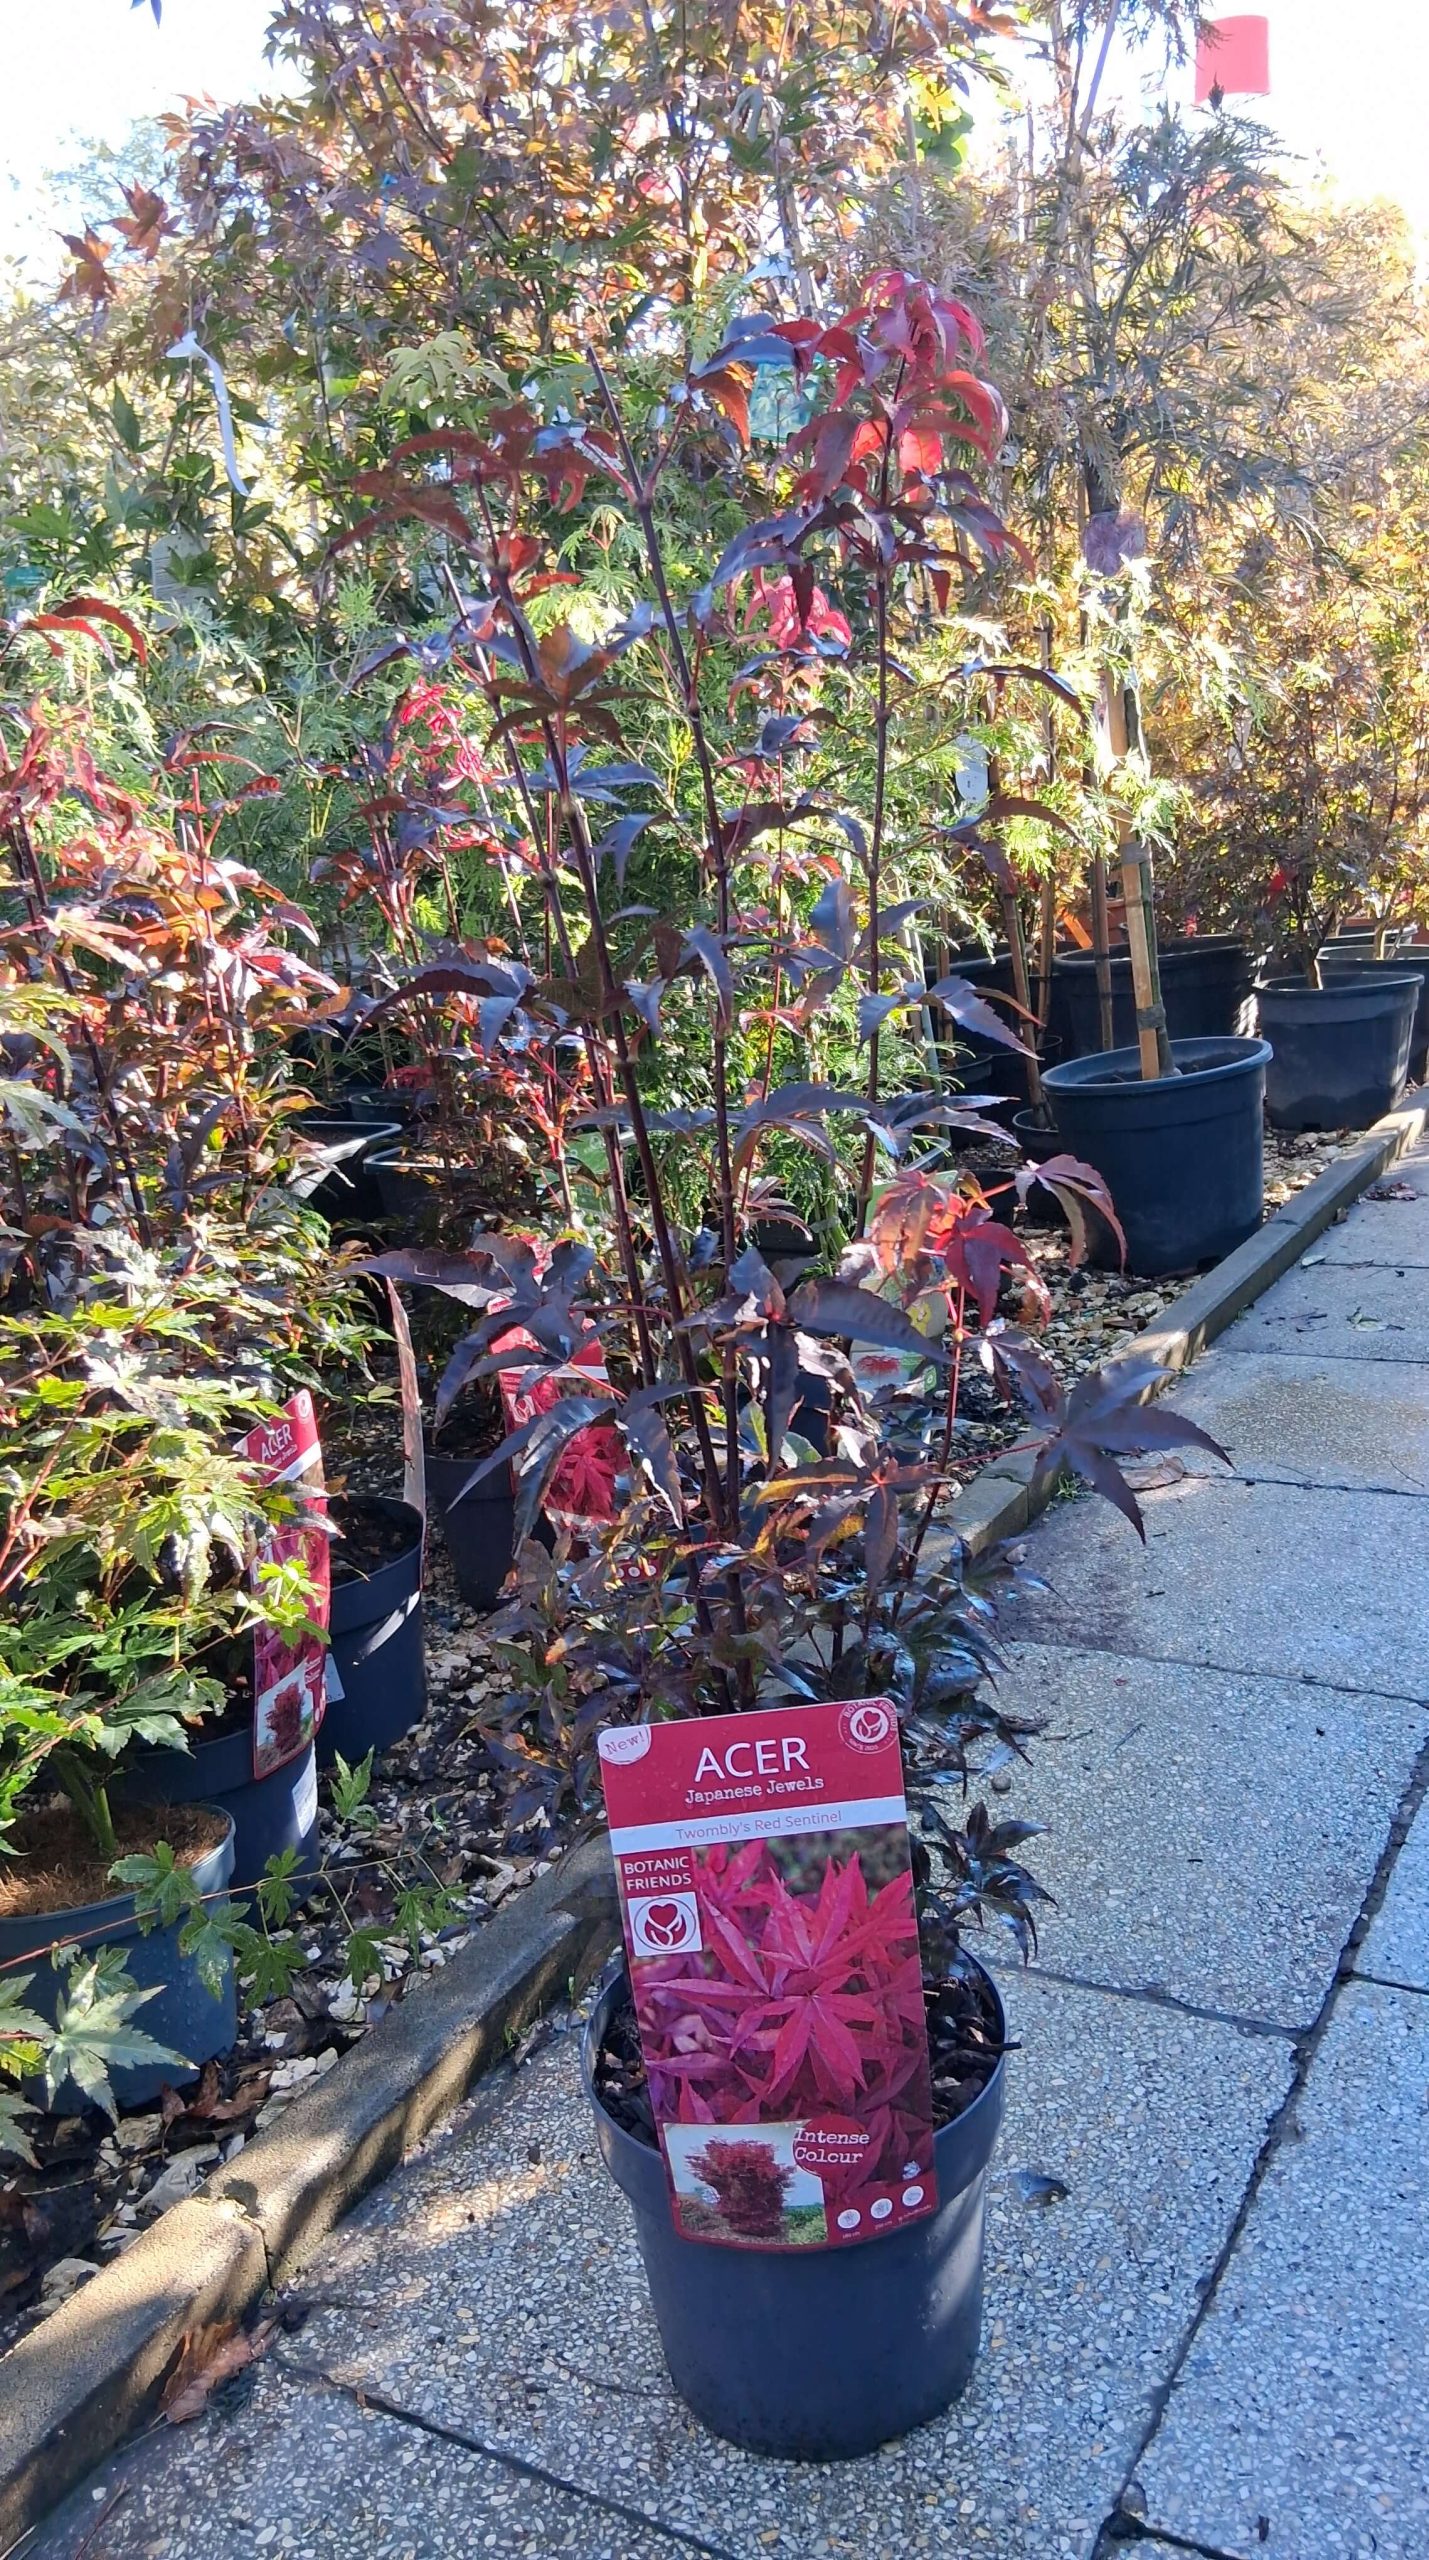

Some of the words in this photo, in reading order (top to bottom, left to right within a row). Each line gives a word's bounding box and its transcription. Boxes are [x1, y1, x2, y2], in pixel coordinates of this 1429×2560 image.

[261, 1423, 293, 1464] ACER
[604, 1731, 645, 1755] New!
[694, 1737, 810, 1783] ACER
[685, 1784, 763, 1805] Japanese
[766, 1776, 824, 1794] Jewels
[676, 1822, 751, 1839] Twombly's
[754, 1817, 781, 1831] Red
[785, 1811, 842, 1828] Sentinel
[623, 1856, 689, 1875] BOTANIC
[626, 1873, 692, 1891] FRIENDS
[794, 2128, 870, 2145] Intense
[794, 2147, 863, 2165] Colour
